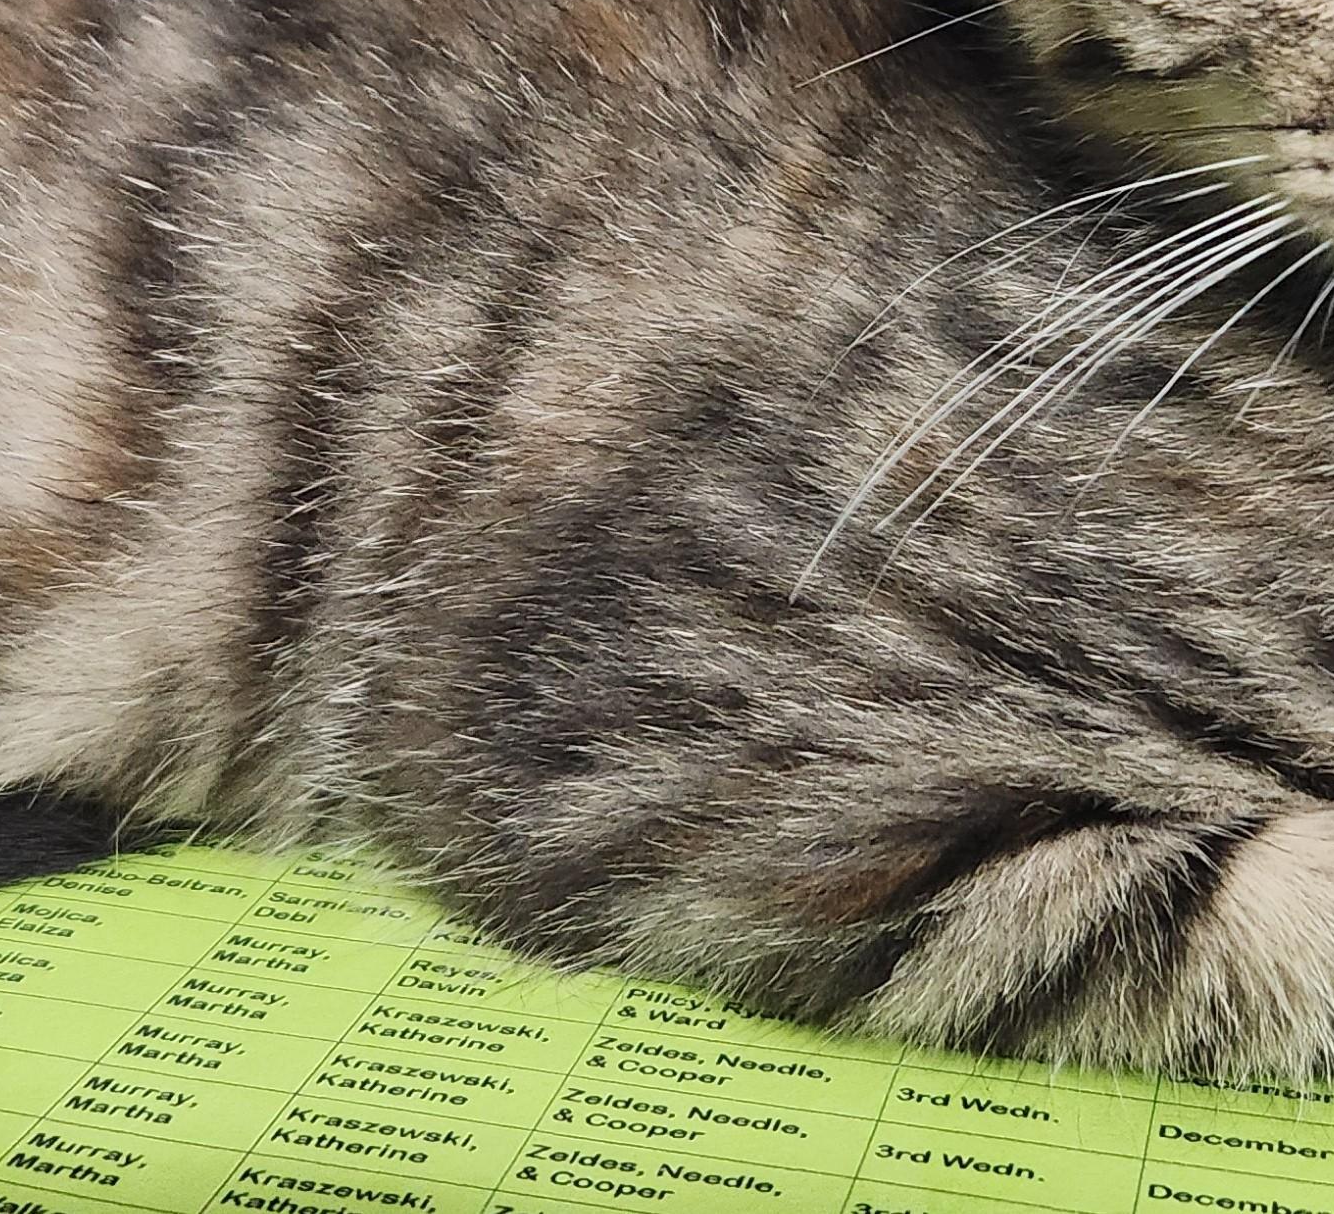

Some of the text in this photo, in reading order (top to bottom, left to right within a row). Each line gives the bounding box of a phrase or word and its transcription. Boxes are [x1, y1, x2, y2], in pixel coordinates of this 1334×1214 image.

[43, 876, 134, 898] Denise
[74, 865, 249, 900] imbo-Beltran,
[11, 902, 105, 927] Mojica,
[254, 905, 319, 924] Debi
[210, 949, 311, 974] Martha
[226, 934, 332, 962] Murray,
[396, 975, 487, 999] Dawin
[408, 958, 504, 984] Reyes,
[166, 993, 269, 1022] Martha
[182, 977, 291, 1008] Murray,
[370, 1003, 551, 1043] Kraszewski,
[615, 1004, 728, 1031] & Ward
[133, 1024, 246, 1056] Murray,
[357, 1020, 506, 1054] Katherine
[116, 1041, 223, 1070] Martha
[585, 1053, 735, 1088] & Cooper
[593, 1035, 834, 1084] Zeldes, Needle,
[315, 1071, 470, 1107] Katherine
[329, 1052, 516, 1095] Kraszewski,
[63, 1094, 174, 1125] Martha
[82, 1075, 199, 1109] Murray,
[895, 1087, 1062, 1124] 3rd Wedn.
[285, 1106, 479, 1153] Kraszewski,
[551, 1106, 706, 1144] & Cooper
[560, 1086, 809, 1140] Zeldes, Needle,
[27, 1132, 148, 1170] Murray,
[269, 1126, 430, 1164] Katherine
[6, 1152, 121, 1188] Martha
[524, 1143, 783, 1198] Zeldes, Needle,
[873, 1143, 1046, 1183] 3rd Wedn.
[238, 1166, 438, 1214] Kraszewski,
[515, 1166, 676, 1202] & Cooper
